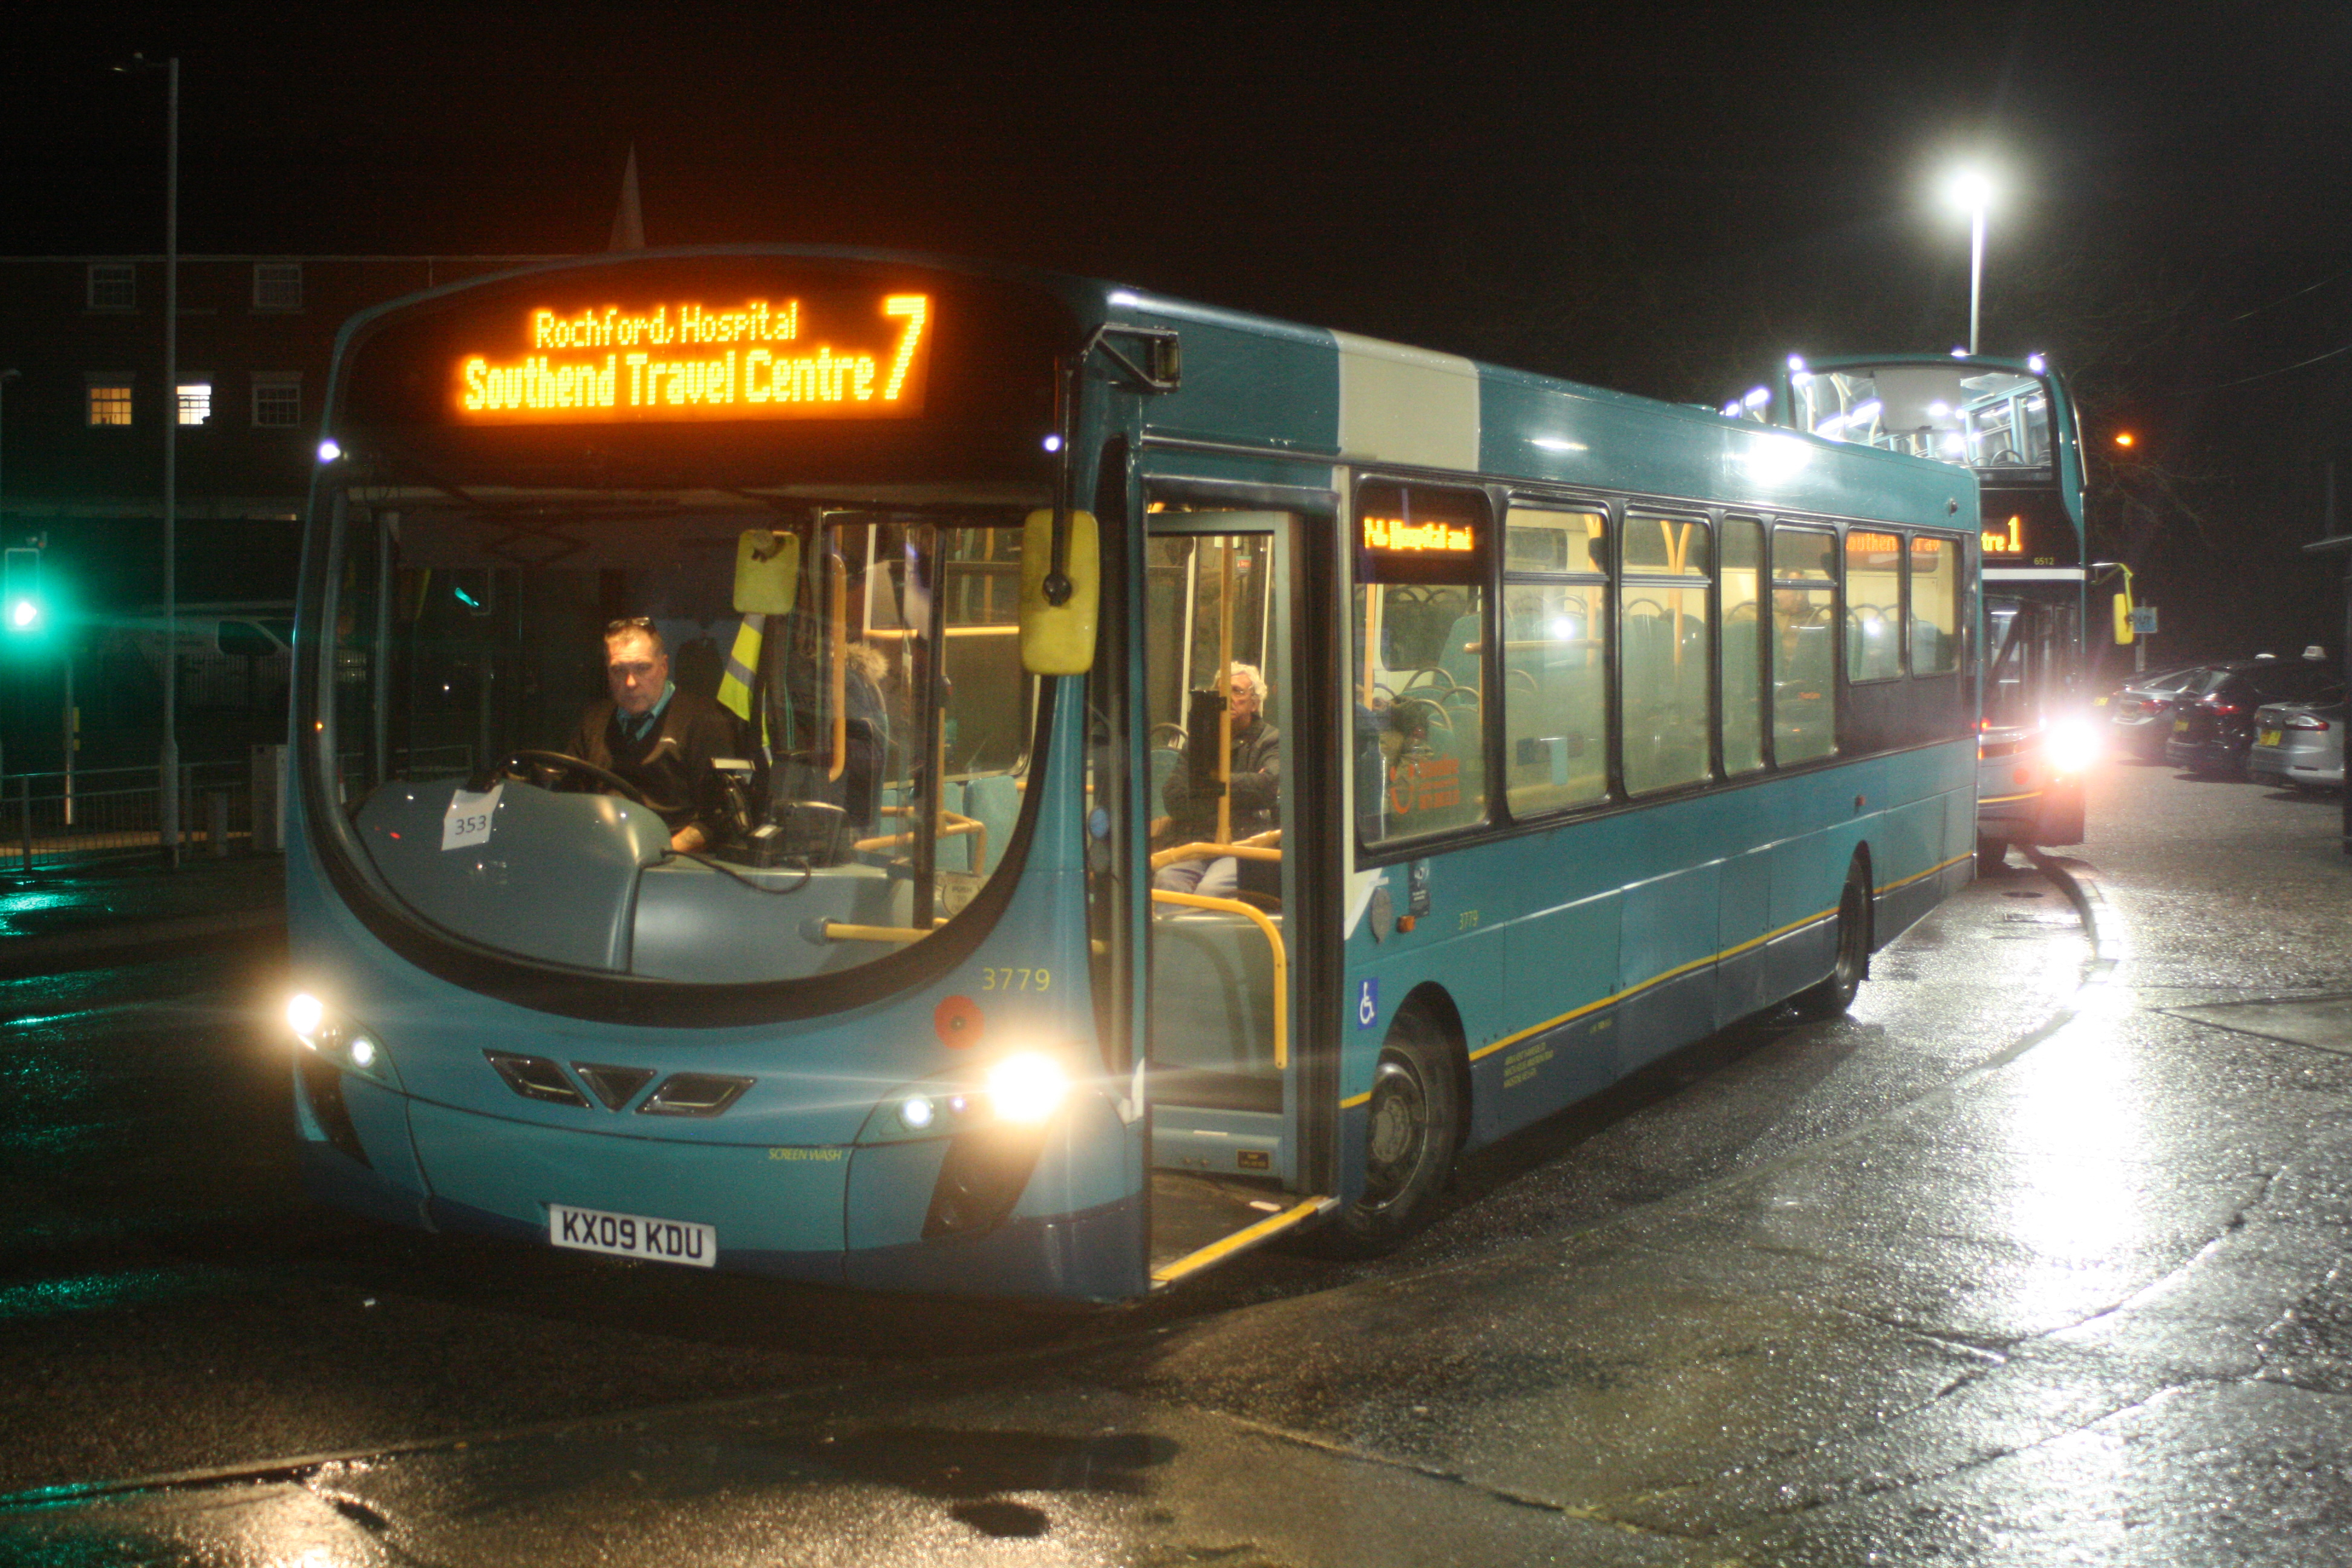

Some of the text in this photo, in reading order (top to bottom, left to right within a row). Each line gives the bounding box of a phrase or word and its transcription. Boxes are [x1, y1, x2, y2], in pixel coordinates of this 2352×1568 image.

[681, 299, 799, 344] Hospital
[884, 294, 928, 400] 7
[465, 347, 875, 410] Southend Travel Centre
[1981, 533, 2005, 551] tre
[2008, 517, 2021, 551] 1
[455, 815, 487, 835] 353
[982, 968, 1051, 991] 3779
[769, 1148, 843, 1161] SCREEN WASH
[562, 1210, 703, 1259] KX09 KDU
